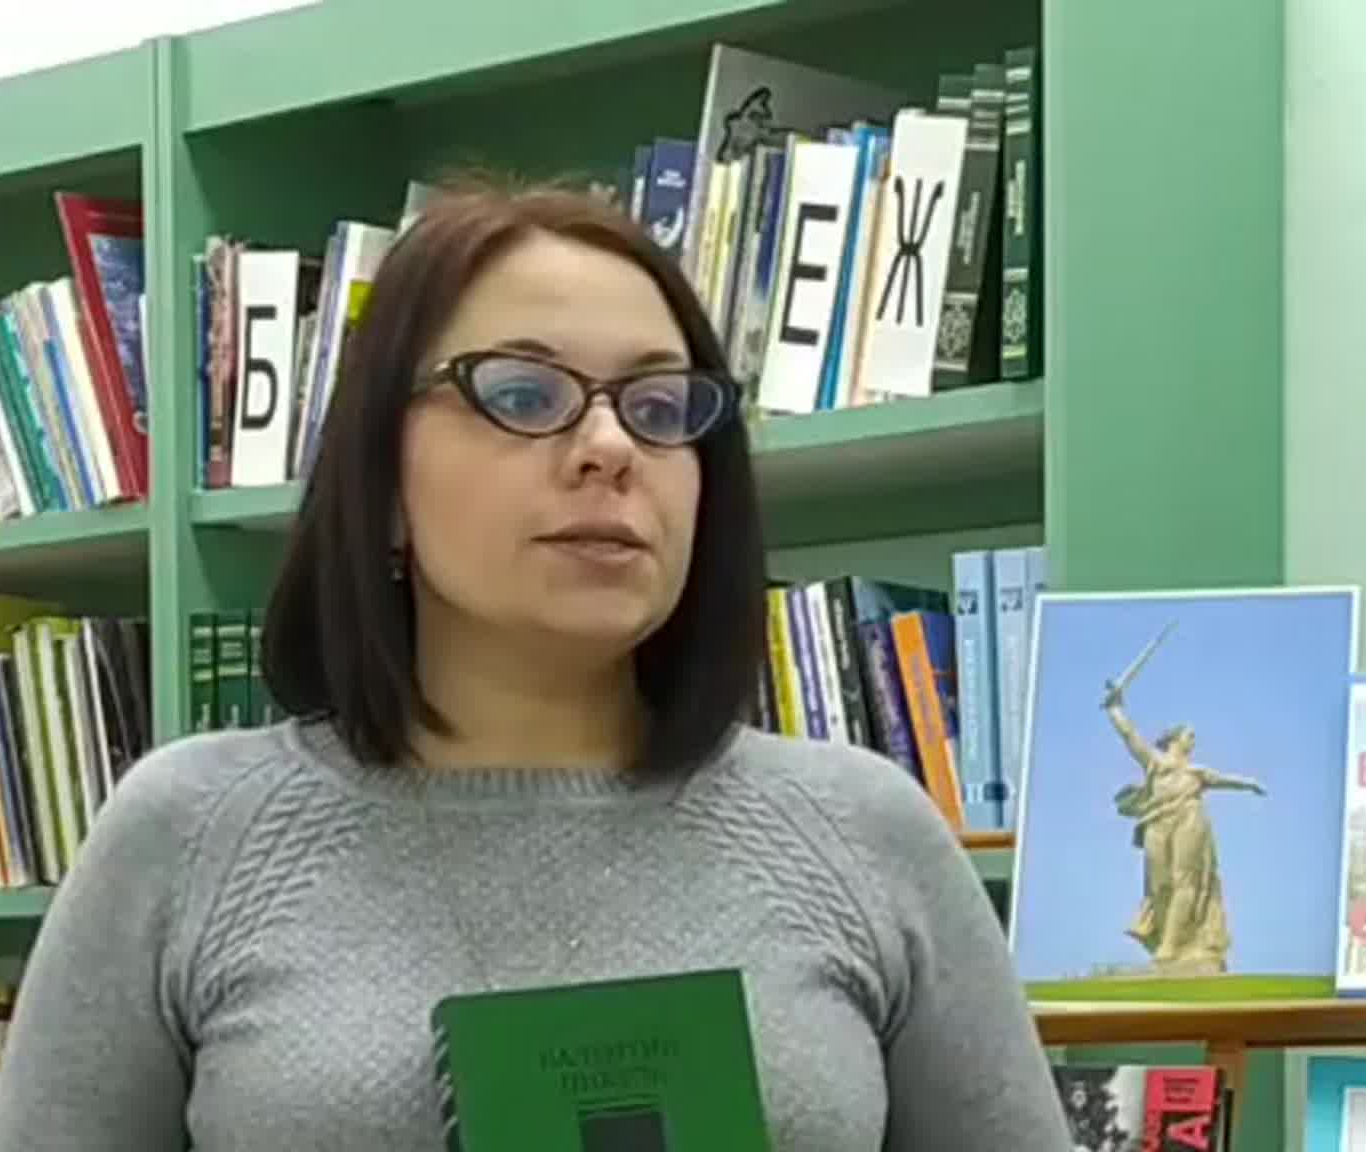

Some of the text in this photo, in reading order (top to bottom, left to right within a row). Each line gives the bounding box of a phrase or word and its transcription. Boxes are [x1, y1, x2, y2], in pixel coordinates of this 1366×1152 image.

[780, 202, 839, 346] Е
[875, 176, 944, 327] Ж
[240, 304, 278, 430] Б
